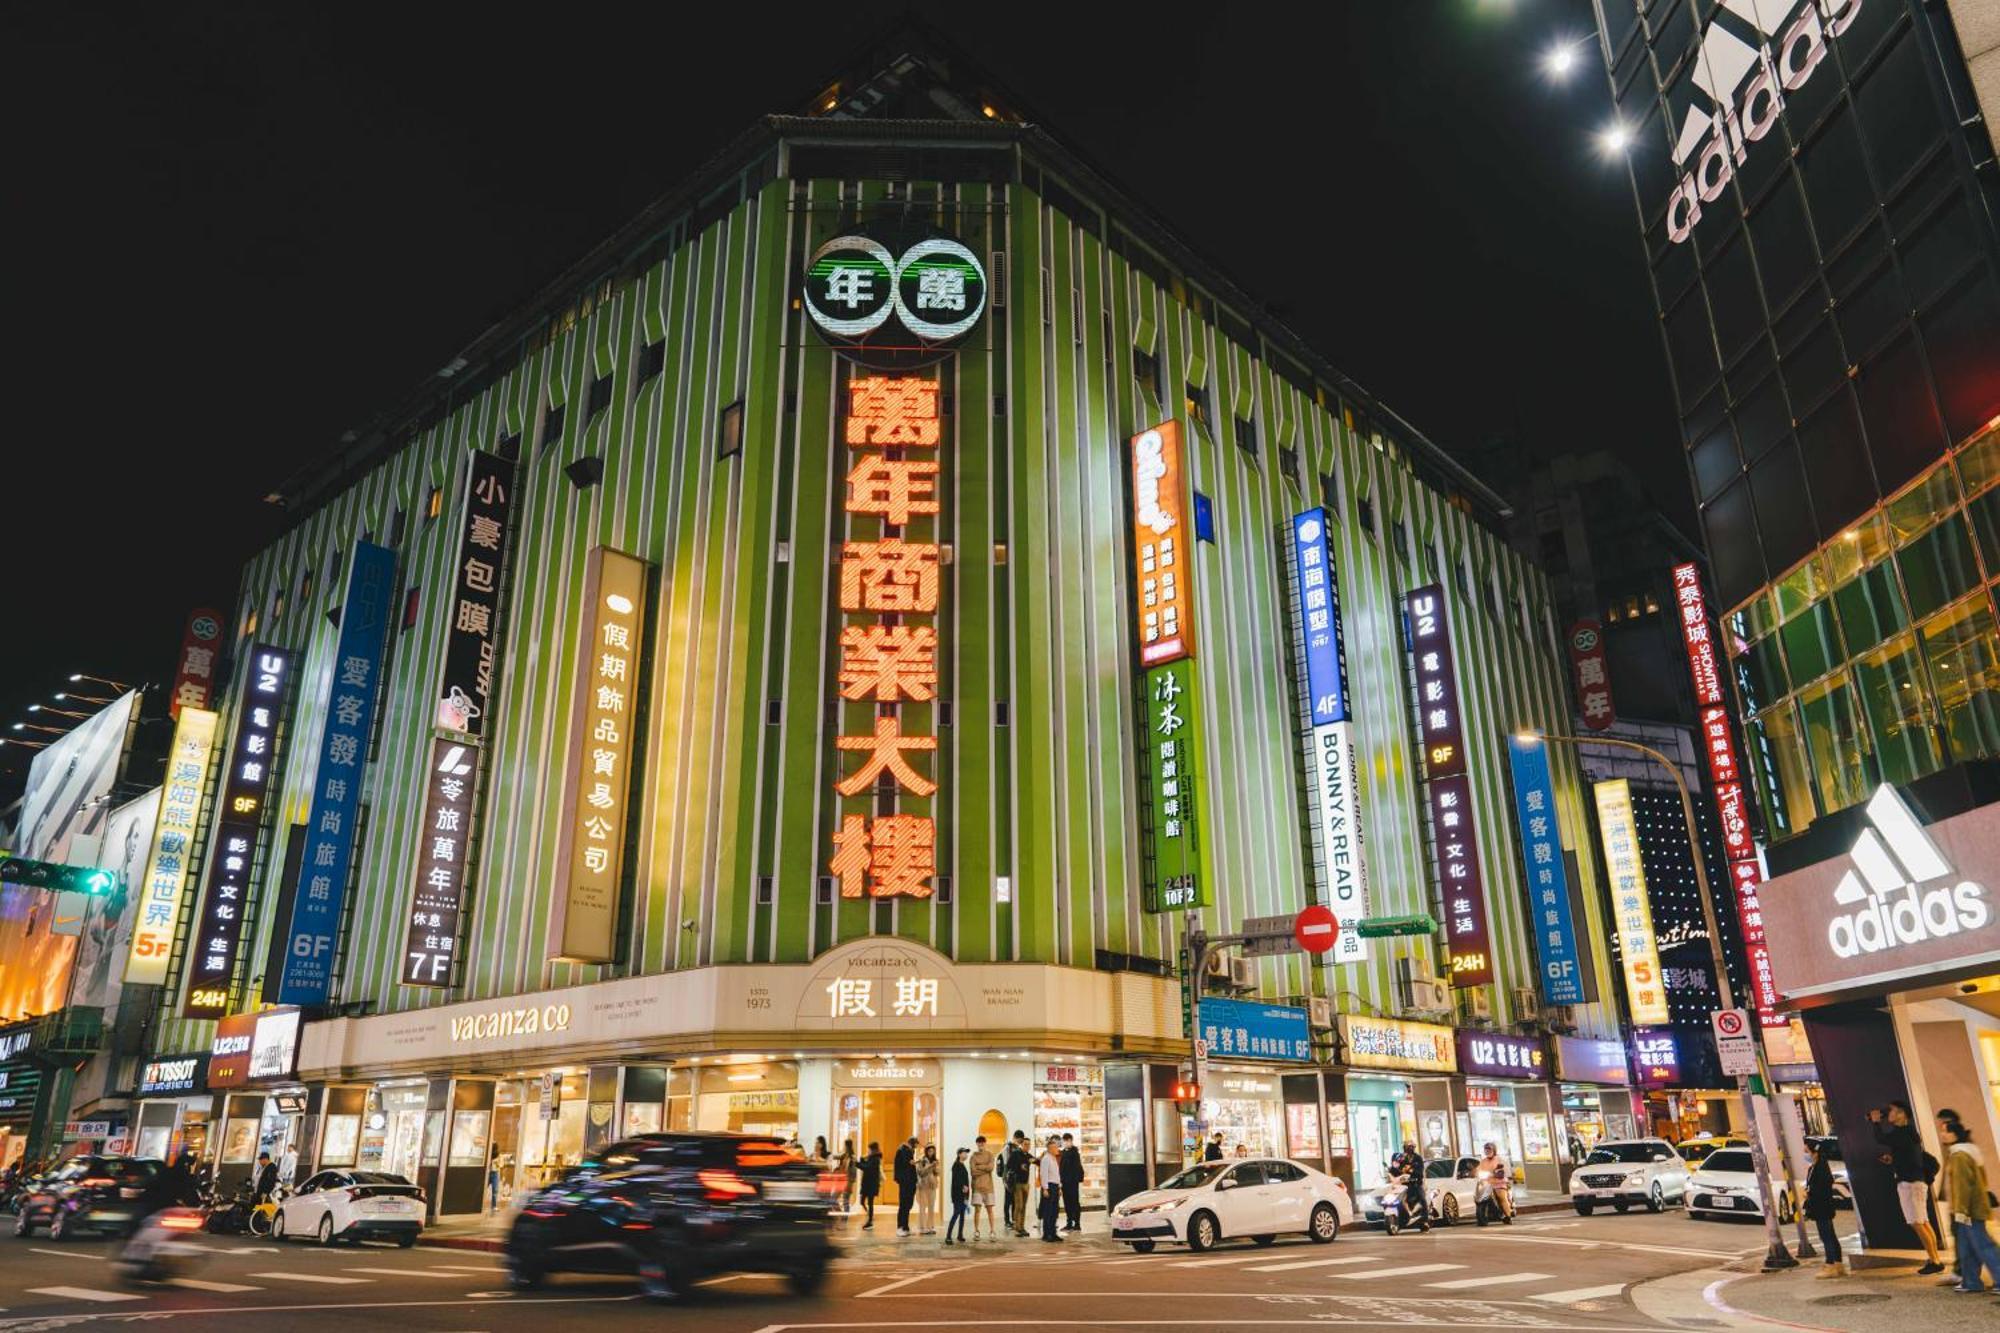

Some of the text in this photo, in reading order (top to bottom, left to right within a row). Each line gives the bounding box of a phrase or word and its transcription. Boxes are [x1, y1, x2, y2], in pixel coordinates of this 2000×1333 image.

[456, 474, 505, 637] 小豪包膜
[1413, 596, 1436, 635] U2
[1676, 565, 1708, 643] 秀泰影城
[832, 376, 940, 899] 萬年商業大樓
[258, 654, 283, 693] U2
[1700, 643, 1720, 702] SHOWTIME
[1578, 657, 1611, 719] 萬年
[1316, 692, 1338, 715] 4F
[583, 620, 630, 874] 假期飾品貿易公司
[1432, 746, 1453, 763] 9F
[234, 797, 257, 813] 9F
[145, 760, 203, 928] 湯姆熊歡樂世界
[427, 777, 465, 892] 苓旅萬年
[413, 911, 441, 928] 休息
[1828, 879, 1988, 959] adidas
[135, 932, 169, 960] 5F
[293, 933, 331, 960] 6F
[425, 935, 454, 951] 住宿
[410, 952, 450, 982] 7F
[847, 957, 901, 967] vacanza
[1452, 954, 1485, 973] 24H
[1547, 960, 1573, 979] 6F
[191, 990, 227, 1008] 24H
[826, 976, 938, 1018] 假期
[451, 1009, 538, 1042] vacanza
[1637, 1039, 1674, 1052] U2
[159, 1059, 198, 1081] TISSOT
[851, 1067, 907, 1078] vacanza
